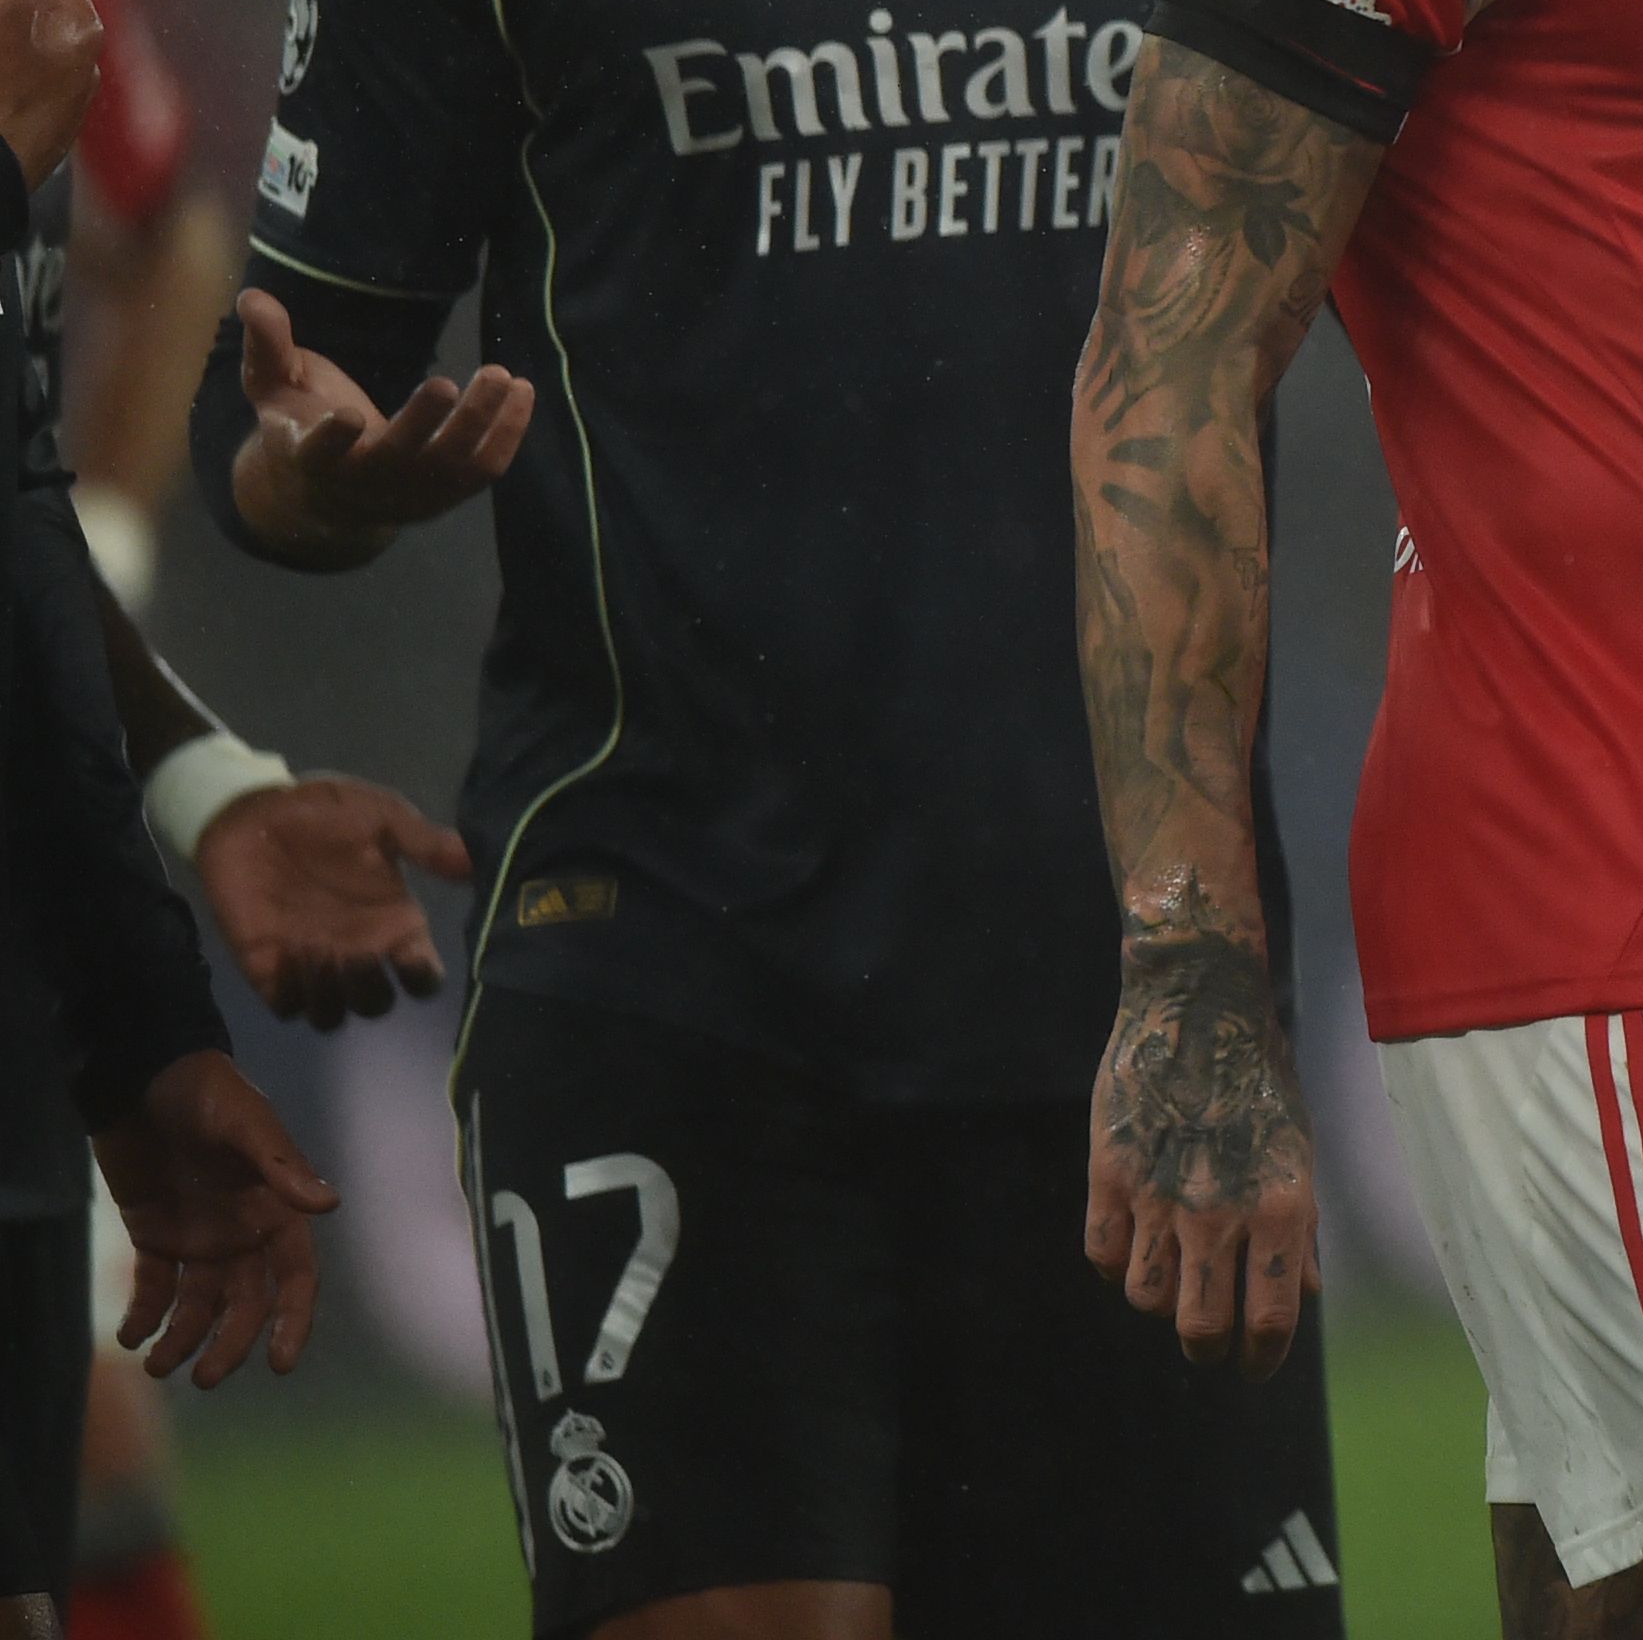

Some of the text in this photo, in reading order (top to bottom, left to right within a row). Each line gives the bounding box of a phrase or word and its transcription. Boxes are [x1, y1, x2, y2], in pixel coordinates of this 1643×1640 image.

[644, 6, 1144, 157] Emirate
[756, 153, 863, 257] FLY
[492, 1152, 682, 1402] 17
